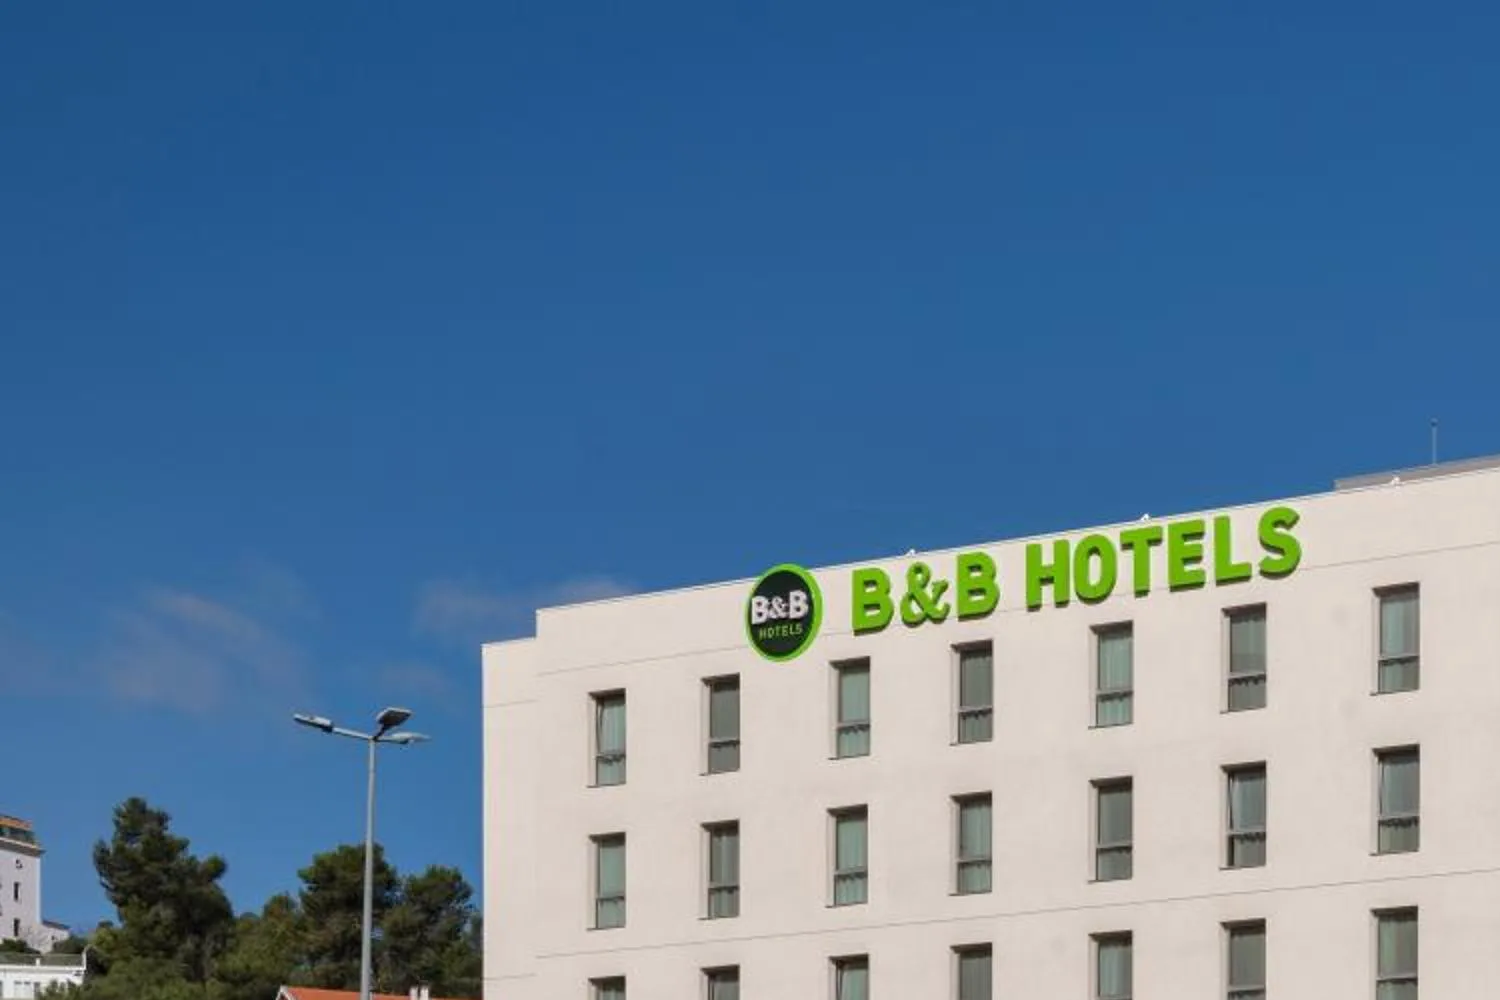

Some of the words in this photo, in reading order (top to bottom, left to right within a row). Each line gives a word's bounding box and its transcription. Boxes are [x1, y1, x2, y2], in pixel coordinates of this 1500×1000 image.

[852, 551, 1000, 636] B&B
[1025, 506, 1302, 611] HOTELS
[751, 590, 809, 625] B&B
[759, 623, 803, 640] HOTELS
